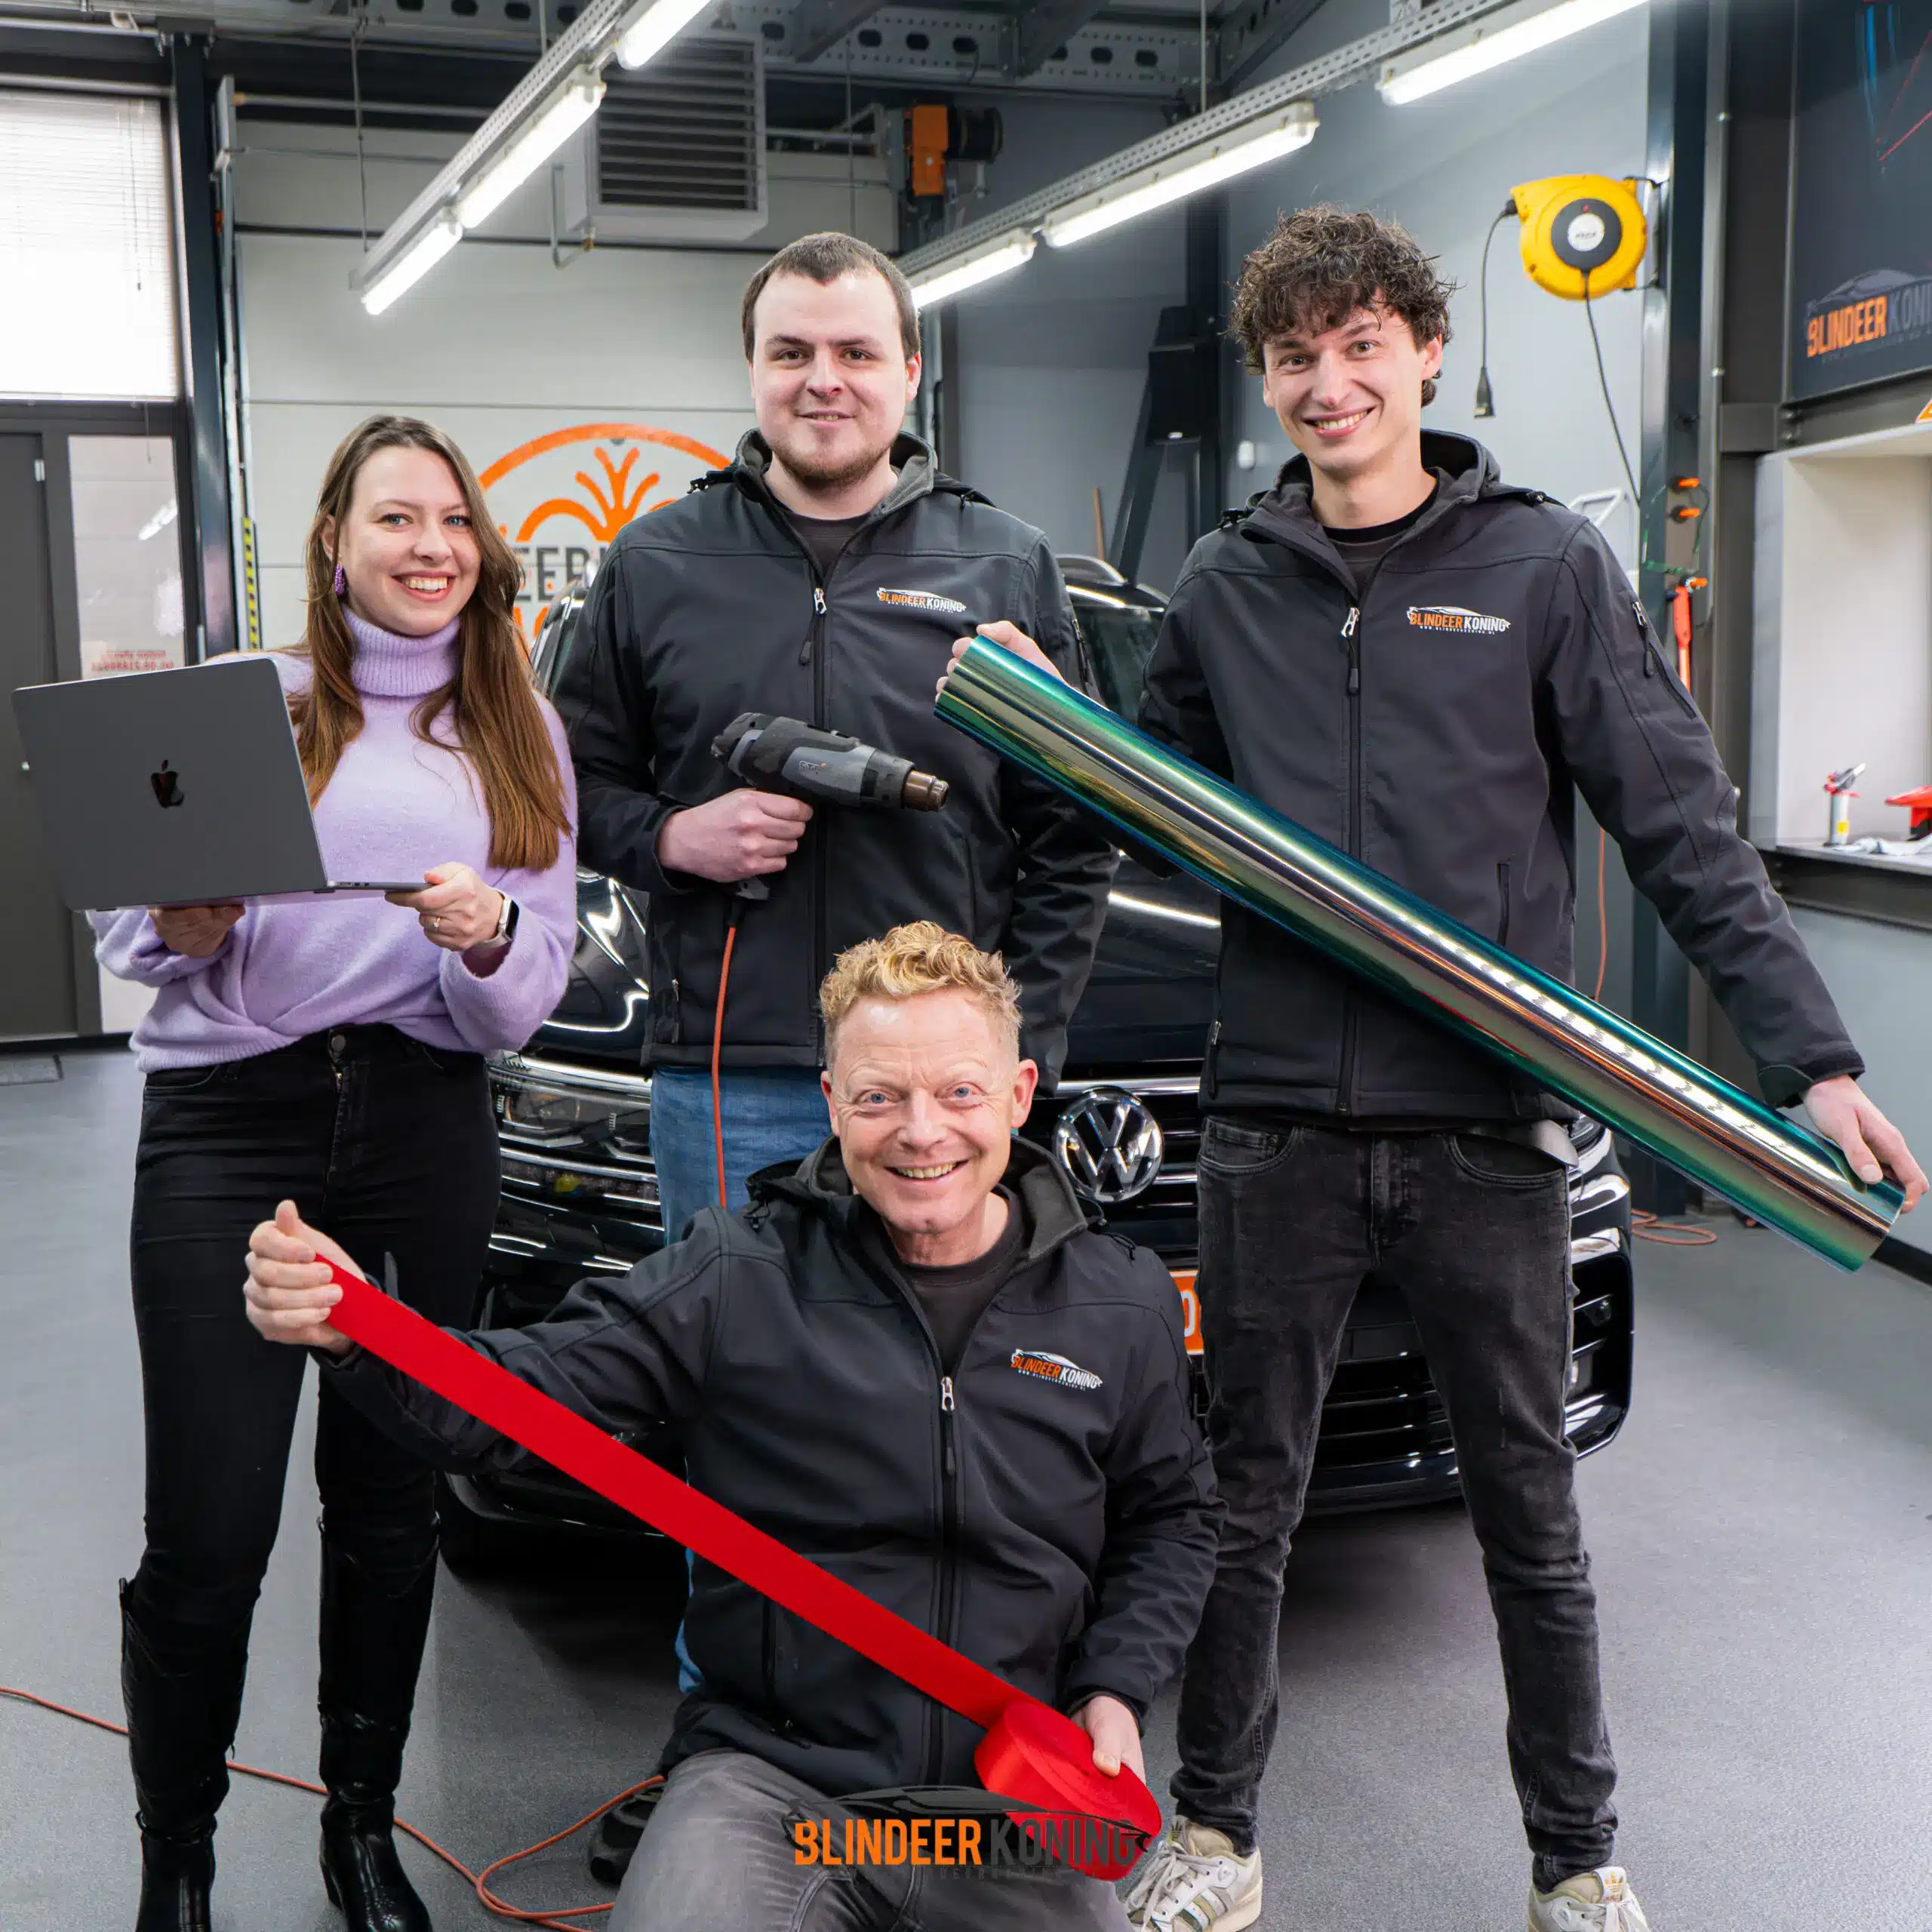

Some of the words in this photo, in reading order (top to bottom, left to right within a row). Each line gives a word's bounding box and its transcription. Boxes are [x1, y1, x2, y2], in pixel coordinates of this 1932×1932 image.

[1807, 295, 1887, 358] BLINDEER
[879, 592, 926, 607] BLINDEER
[927, 598, 962, 613] KONING
[1409, 612, 1463, 629] BLINDEER
[1464, 617, 1506, 632] KONING
[1011, 1355, 1062, 1380] BLINDEER
[1060, 1367, 1099, 1389] KONING
